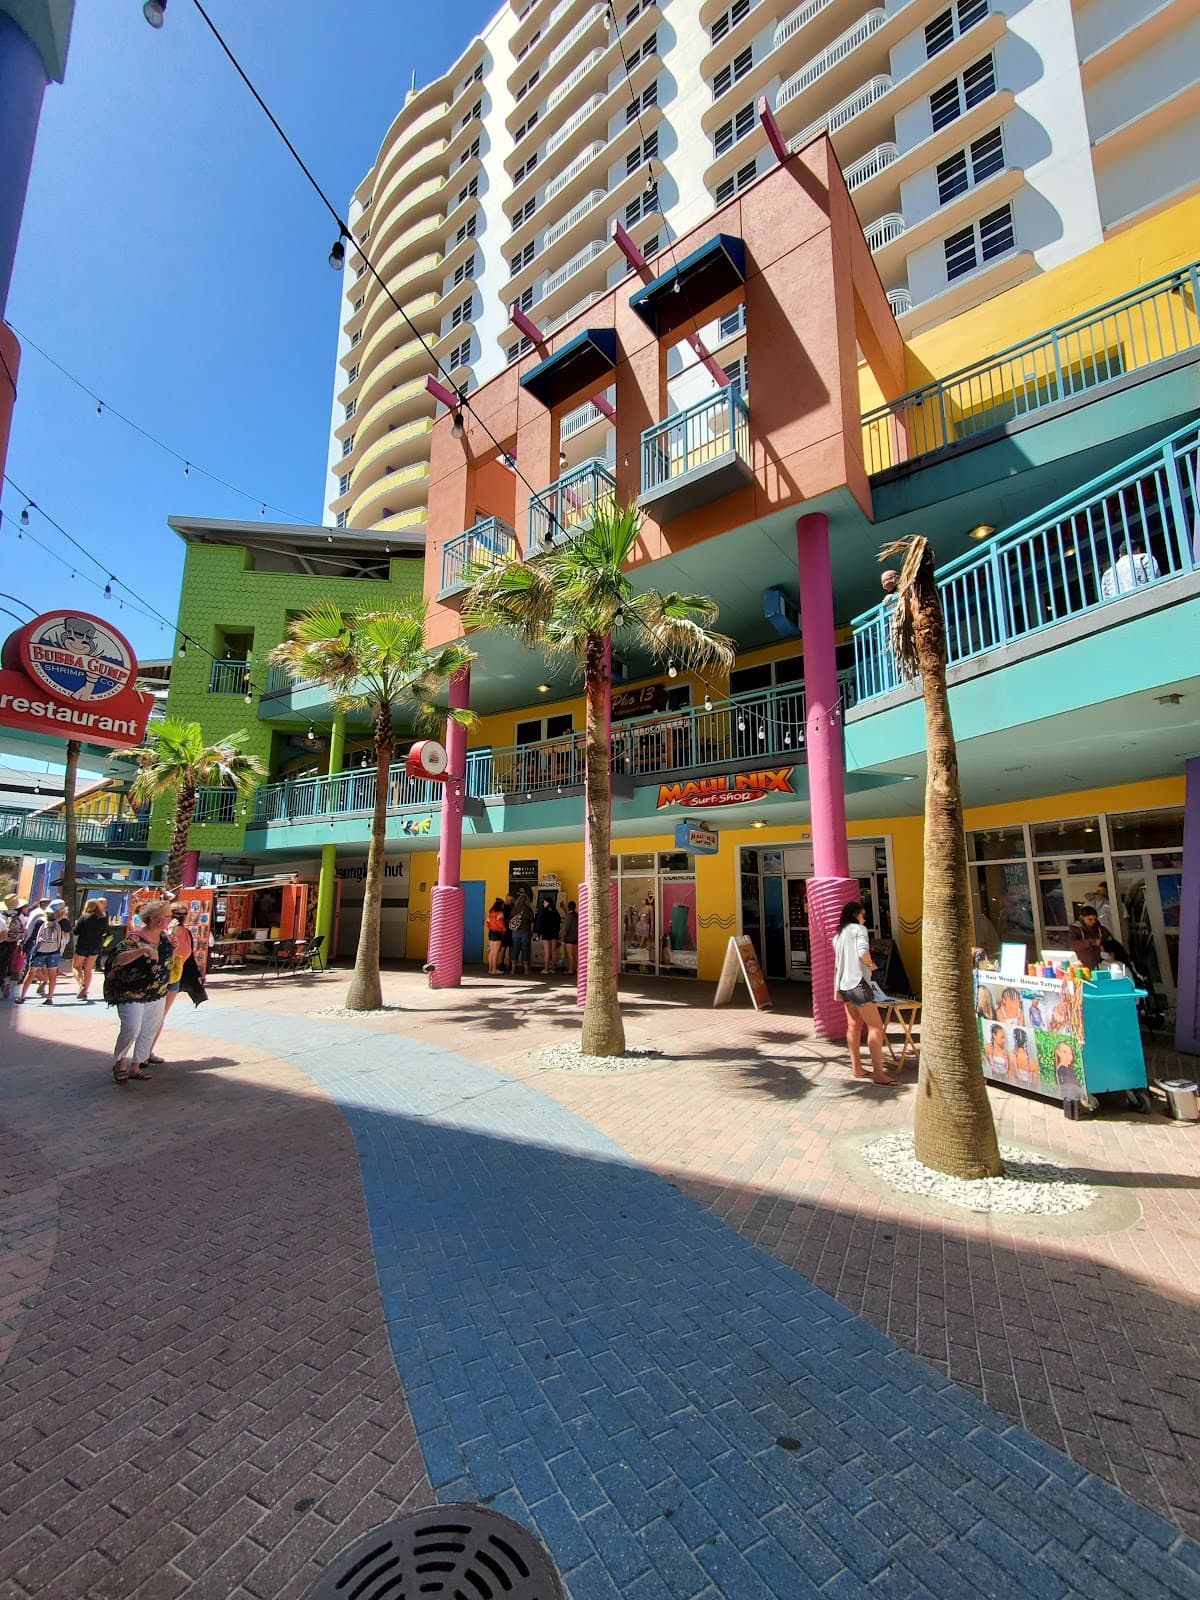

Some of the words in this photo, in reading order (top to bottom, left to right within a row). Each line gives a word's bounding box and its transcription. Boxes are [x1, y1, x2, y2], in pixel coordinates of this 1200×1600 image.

[32, 645, 85, 670] BUBBA
[87, 657, 129, 682] GUMP
[44, 664, 86, 678] SHRIMP
[99, 678, 115, 688] CO
[611, 692, 635, 711] Pho
[639, 686, 656, 703] 13
[0, 694, 139, 736] restaurant
[656, 776, 728, 810] MAUI
[735, 766, 794, 793] NIX
[690, 795, 718, 807] Surf
[384, 861, 404, 877] hut
